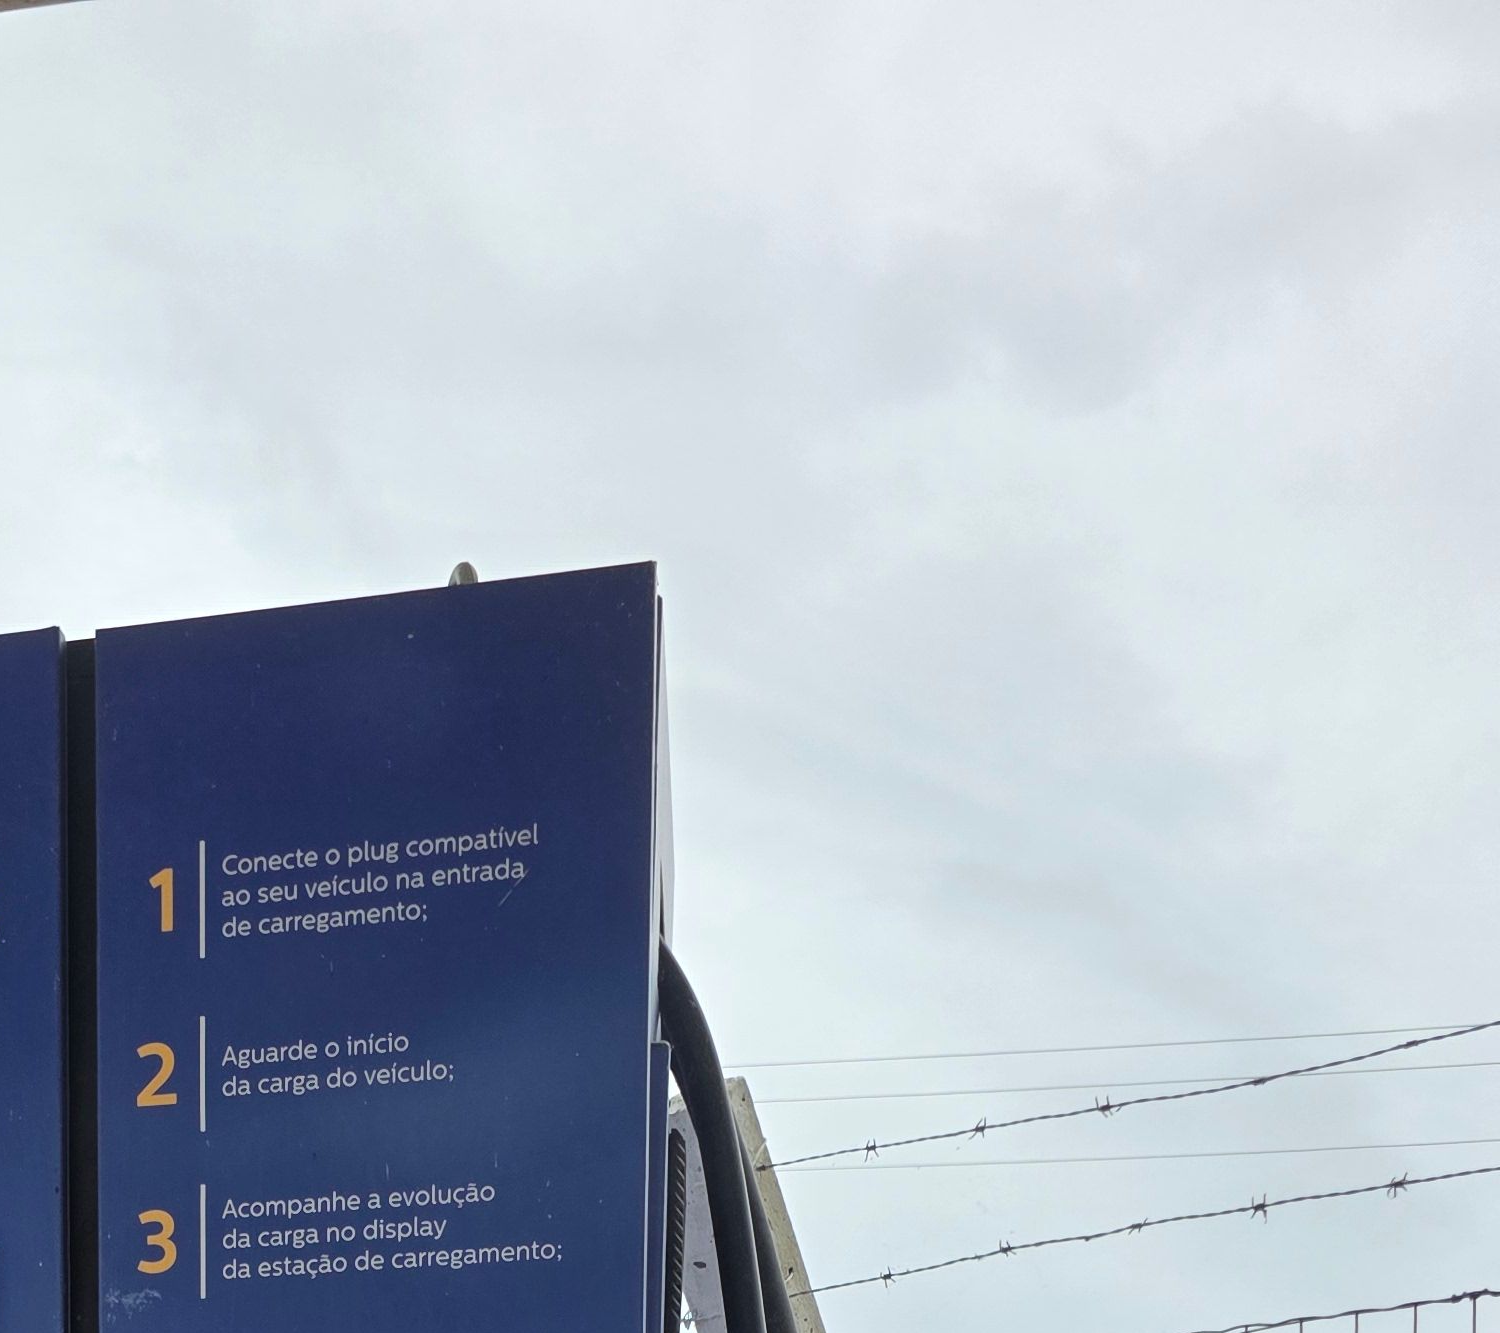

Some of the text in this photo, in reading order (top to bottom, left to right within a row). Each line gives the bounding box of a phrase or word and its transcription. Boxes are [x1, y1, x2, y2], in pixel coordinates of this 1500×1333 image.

[222, 823, 539, 876] Conecte o plug compatível
[148, 868, 174, 932] 1
[222, 858, 526, 907] ao seu veículo na entrada
[222, 902, 428, 938] de carregamento;
[222, 1033, 409, 1069] Aguarde o início
[136, 1041, 178, 1107] 2
[222, 1059, 454, 1097] da carga do veículo;
[222, 1182, 496, 1220] Acompanhe a evolução
[136, 1209, 178, 1275] 3
[222, 1216, 448, 1250] da carga no display
[222, 1240, 563, 1280] da estação de carregamento;
